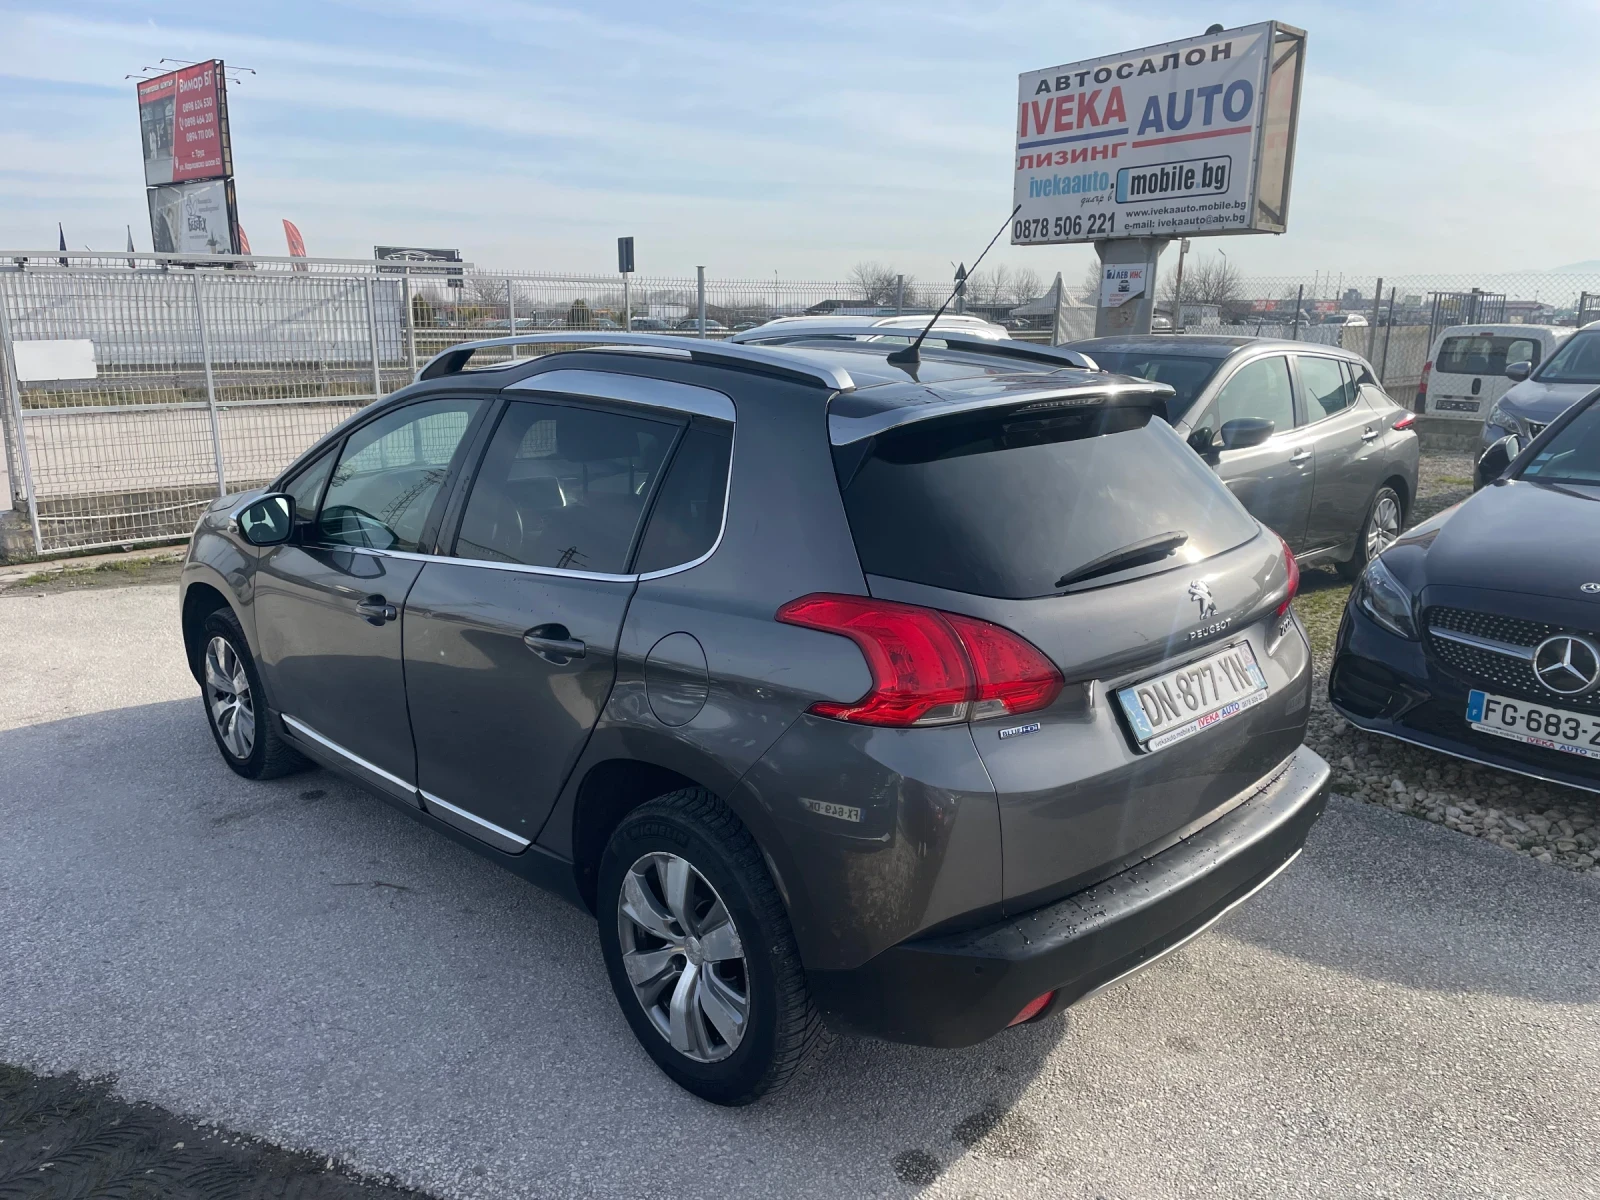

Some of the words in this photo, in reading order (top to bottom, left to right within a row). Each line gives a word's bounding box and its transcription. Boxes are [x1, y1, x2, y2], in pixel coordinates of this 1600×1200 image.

[179, 76, 203, 93] Вимар
[204, 70, 213, 86] БГ
[1035, 42, 1232, 95] АВТОСАЛОН
[1020, 86, 1127, 138] IVEKA
[1137, 79, 1254, 136] AUTO
[1017, 142, 1128, 170] ЛИЗИНГ
[1130, 162, 1226, 195] mobile.bg
[1124, 219, 1155, 230] e-mail:
[1157, 213, 1245, 227] ivekaauto@abv.bg
[1125, 200, 1246, 218] www.ivekaauto.mobile.bg
[1014, 217, 1049, 239] 0878
[1053, 215, 1082, 237] 506
[1087, 211, 1115, 234] 221
[1189, 617, 1231, 641] PEUGEOT
[1138, 653, 1252, 728] DN-877-YN
[1197, 711, 1220, 728] IVEKA
[1221, 702, 1240, 717] AUTO
[1484, 699, 1600, 746] FG-683-Z
[1526, 736, 1555, 748] IVEKA
[1559, 743, 1588, 755] AUTO
